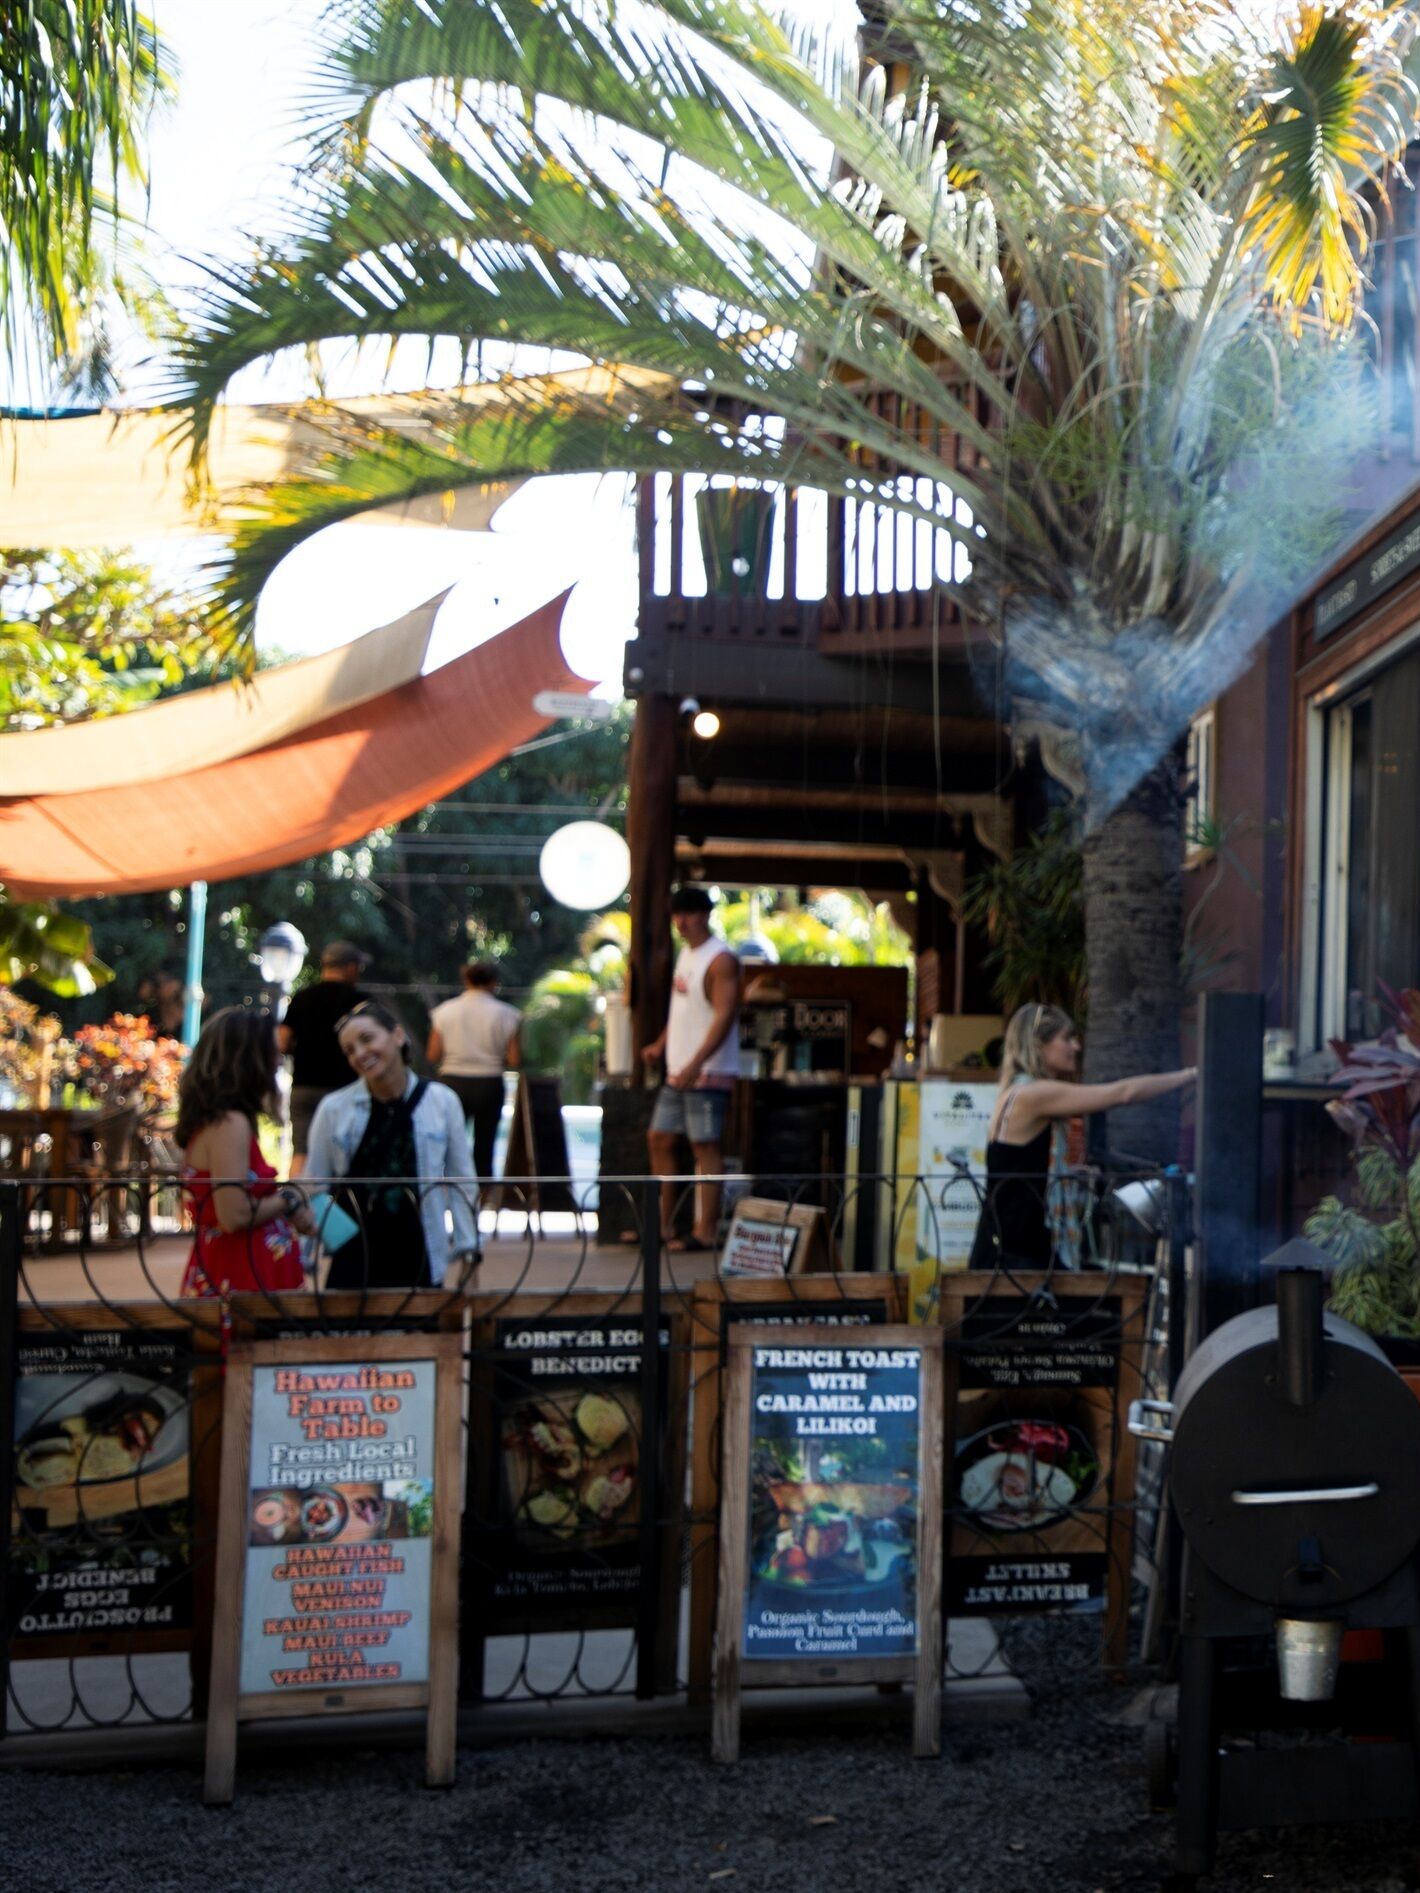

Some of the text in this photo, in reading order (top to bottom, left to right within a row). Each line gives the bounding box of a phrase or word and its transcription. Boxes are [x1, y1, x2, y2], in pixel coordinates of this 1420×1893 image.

[505, 1331, 606, 1349] LOBSTER
[531, 1356, 641, 1375] BENEDICT
[755, 1350, 920, 1370] FRENCH TOAST
[274, 1368, 415, 1393] Hawaiian
[808, 1373, 867, 1390] WITH
[289, 1394, 400, 1418] Farm to
[757, 1395, 918, 1412] CARAMEL AND
[302, 1416, 388, 1440] Table
[796, 1417, 876, 1435] LILIKOI
[271, 1436, 415, 1465] Fresh Local
[269, 1462, 416, 1488] Ingredients
[36, 1569, 156, 1591] BENEDICT
[64, 1588, 129, 1608] EGGS
[965, 1583, 1090, 1602] BREAKFAST
[20, 1605, 173, 1632] PROSCIUTTO
[761, 1609, 820, 1627] Organic
[748, 1621, 914, 1639] Passion Fruit Curd and
[795, 1637, 857, 1652] Caramel
